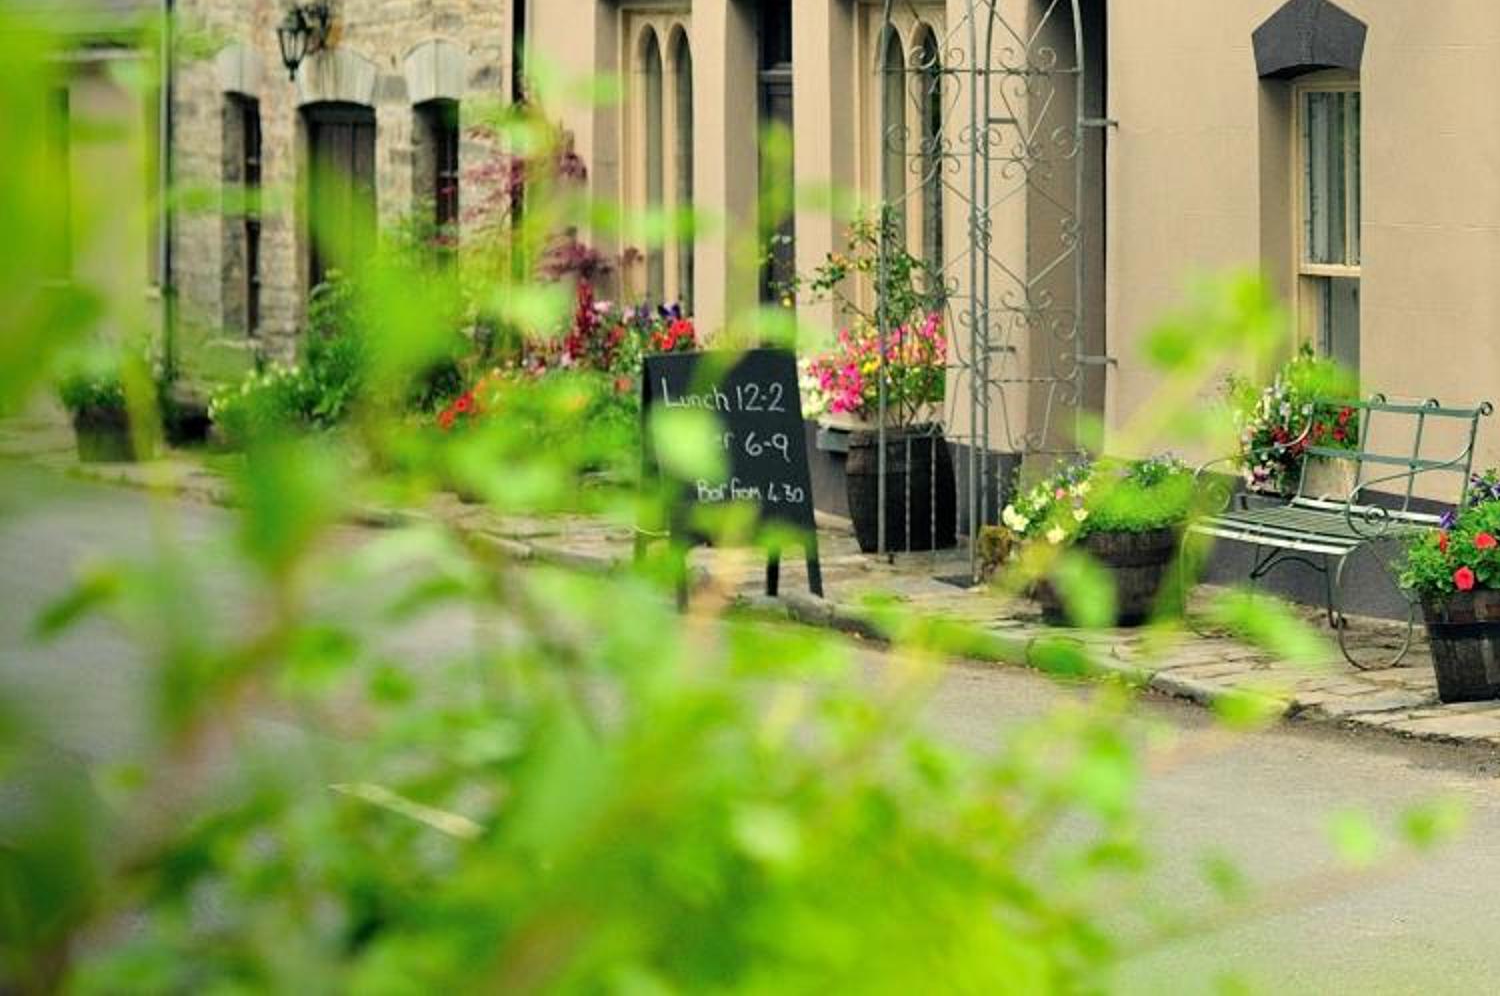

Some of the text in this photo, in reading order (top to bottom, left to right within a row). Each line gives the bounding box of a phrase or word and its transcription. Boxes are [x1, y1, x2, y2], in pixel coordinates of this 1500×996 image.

[661, 376, 732, 412] Lunch
[745, 430, 791, 463] 6-9
[696, 478, 727, 503] Bar
